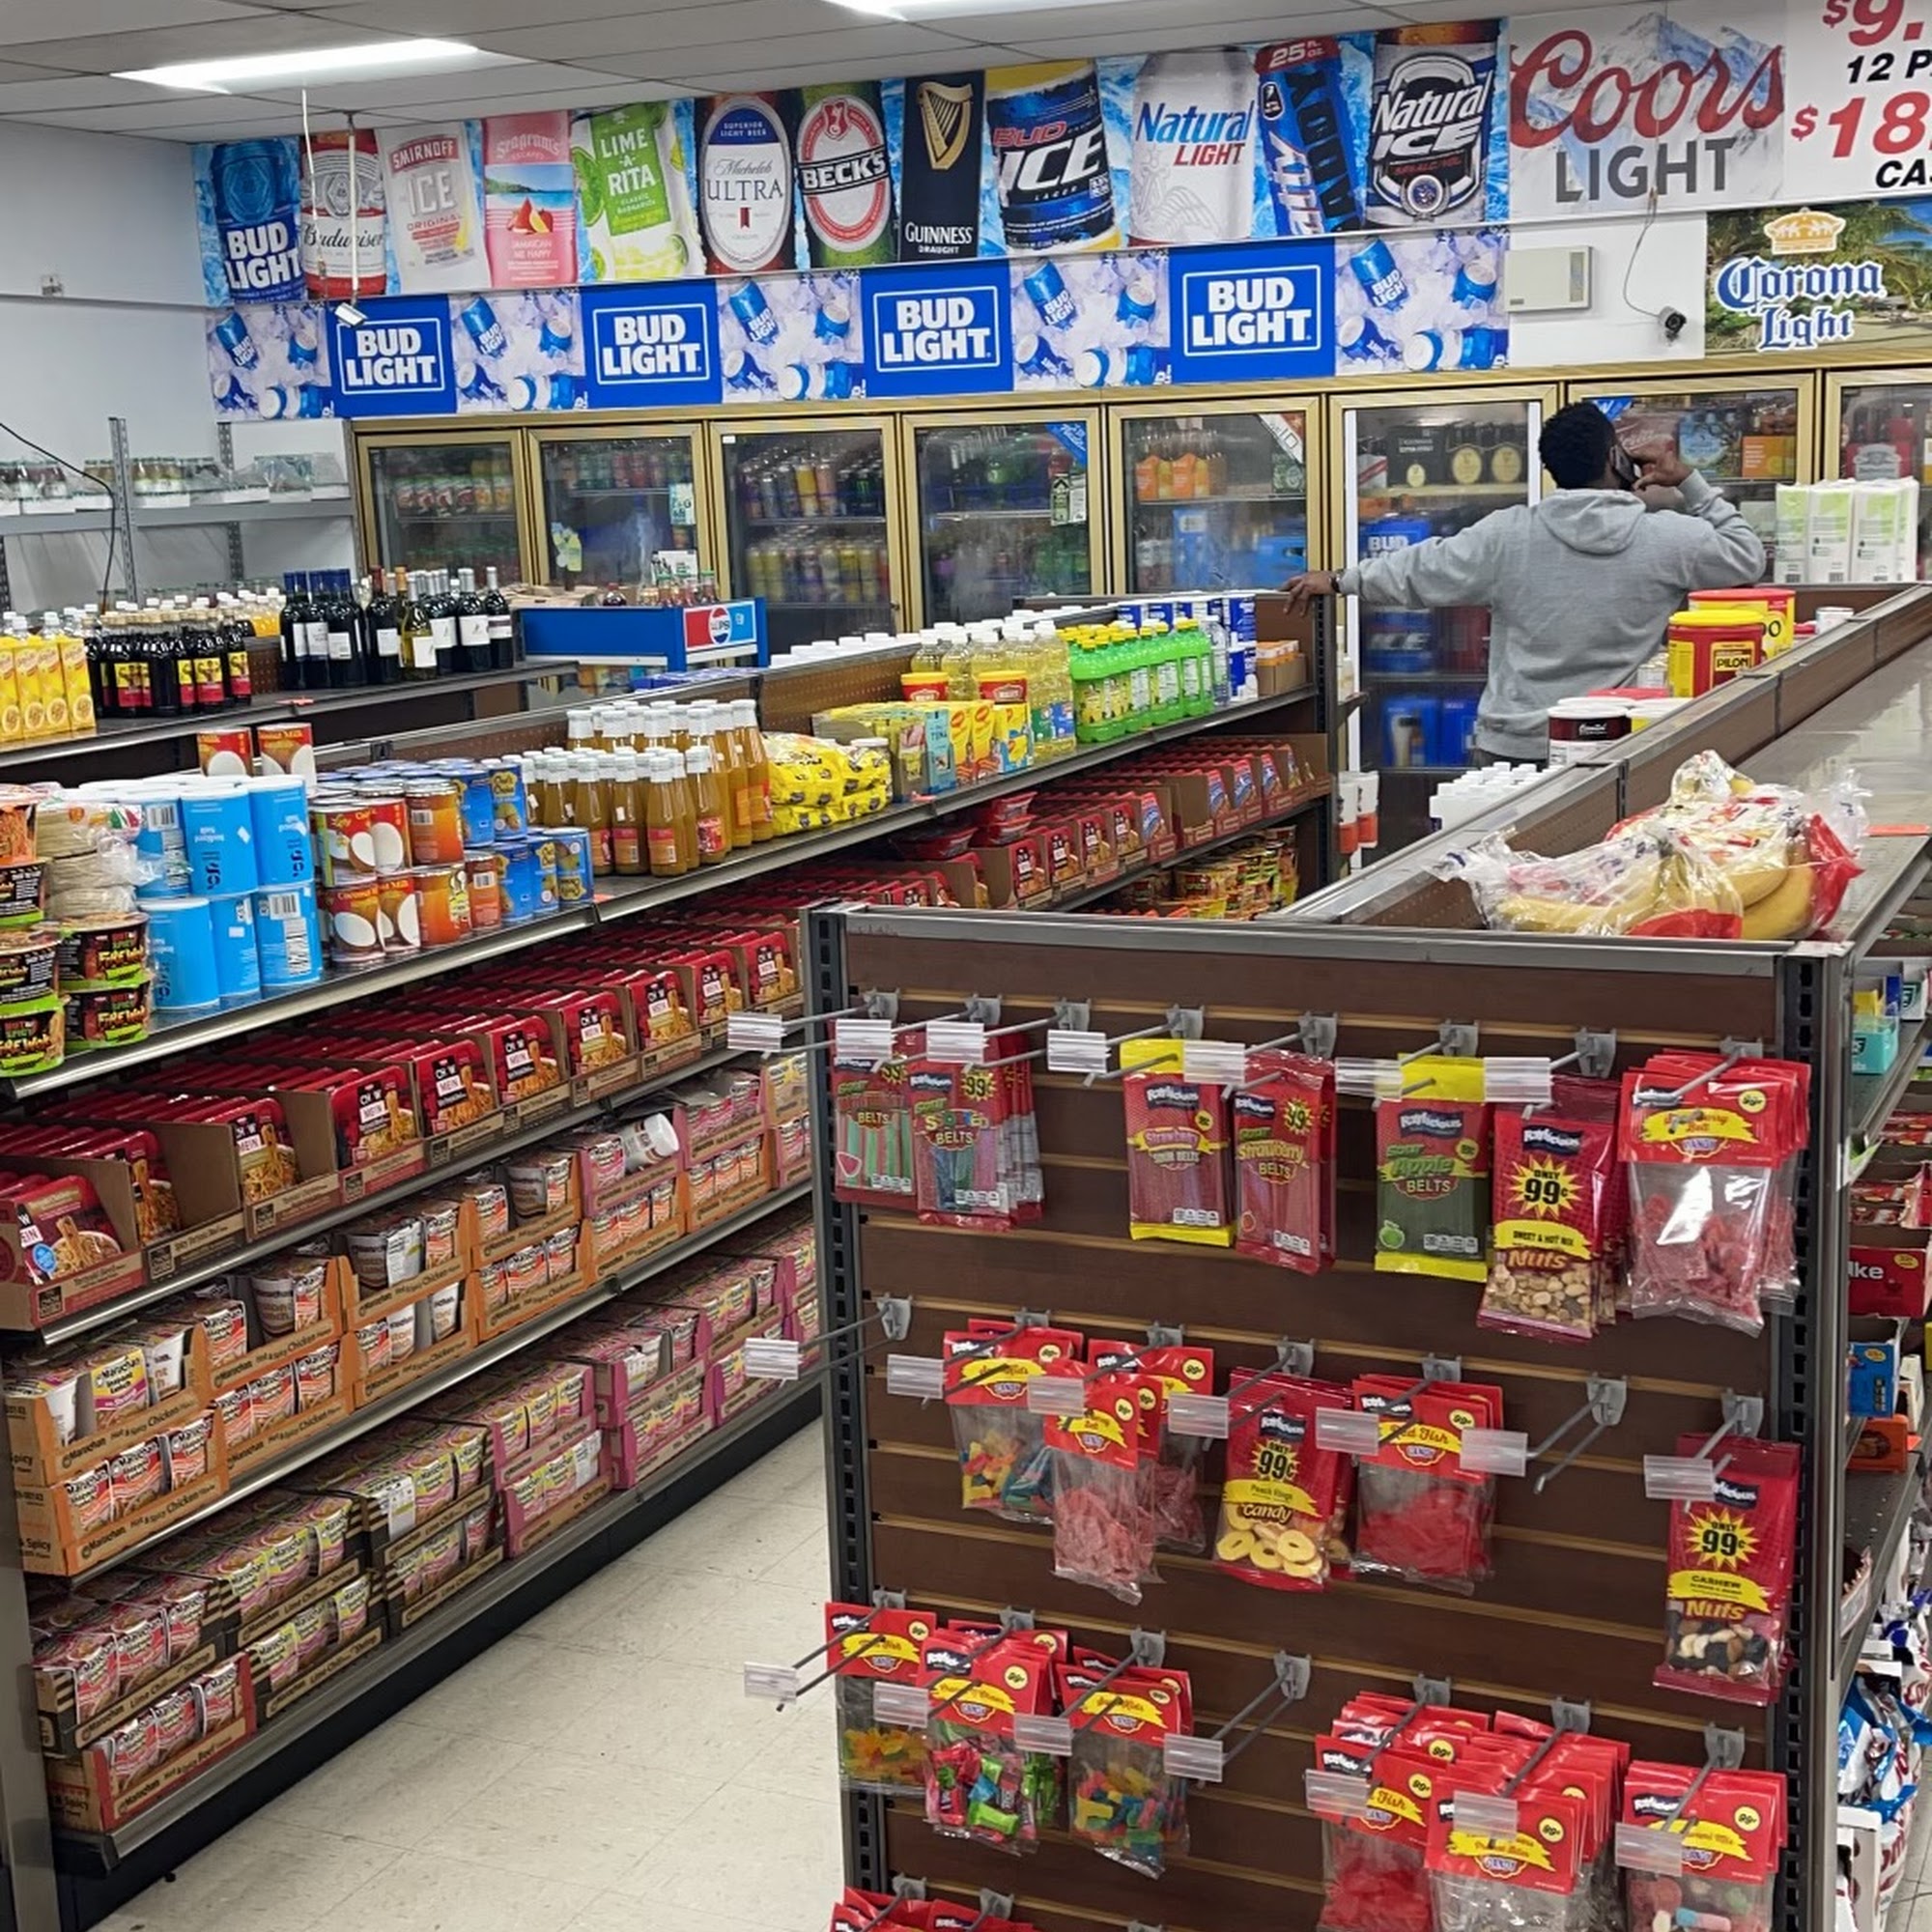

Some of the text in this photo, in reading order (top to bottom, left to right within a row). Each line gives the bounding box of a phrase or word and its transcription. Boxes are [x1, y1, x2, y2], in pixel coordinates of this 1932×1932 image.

[1268, 43, 1304, 69] 25
[1847, 49, 1932, 84] 12 P
[1373, 70, 1493, 132] Natural
[1510, 30, 1784, 148] Coors
[993, 121, 1067, 147] BUD
[1136, 100, 1255, 143] Natural
[1791, 91, 1932, 158] $18
[601, 128, 649, 158] LIME
[1286, 71, 1362, 232] ADDY
[1373, 117, 1482, 161] ICE
[392, 140, 455, 169] SMIRNOFF
[714, 158, 773, 177] Michelob
[801, 150, 887, 189] BECK'S
[999, 124, 1103, 207] ICE
[1174, 143, 1245, 166] LIGHT
[607, 164, 657, 197] RITA
[1269, 131, 1326, 236] atty
[1556, 137, 1737, 203] LIGHT
[1876, 158, 1932, 188] CA
[408, 170, 456, 216] ICE
[707, 179, 784, 202] ULTRA
[227, 222, 289, 260] BUD
[301, 222, 384, 248] Budwiser
[905, 222, 974, 244] GUINNESS
[919, 245, 959, 254] DRAUGHT
[224, 249, 302, 291] LIGHT
[1372, 270, 1401, 293] BUD
[1717, 256, 1886, 313] Corona
[1043, 290, 1071, 315] BUD
[1208, 277, 1295, 312] BUD
[896, 298, 975, 331] BUD
[1192, 309, 1312, 347] LIGHT
[1758, 306, 1854, 350] Light
[355, 327, 421, 357] BUD
[613, 314, 686, 346] BUD
[883, 328, 990, 362] LIGHT
[346, 355, 437, 386] LIGHT
[603, 343, 701, 376] LIGHT
[1368, 535, 1408, 551] BUD
[858, 1112, 889, 1124] BELTS
[936, 1132, 974, 1146] BELTS
[1238, 1141, 1304, 1164] Strawberry
[1259, 1162, 1292, 1179] BELTS
[1533, 1169, 1561, 1180] ONLY
[1406, 1179, 1450, 1193] BELTS
[1514, 1231, 1536, 1240] SWEET
[1544, 1235, 1559, 1244] HOT
[1509, 1249, 1567, 1268] Nuts
[1420, 1427, 1450, 1444] Fish
[1242, 1503, 1292, 1523] Candy
[1711, 1521, 1738, 1532] ONLY
[1691, 1575, 1742, 1589] CASHEW
[1687, 1600, 1746, 1619] Nuts
[1378, 1790, 1407, 1810] Fish
